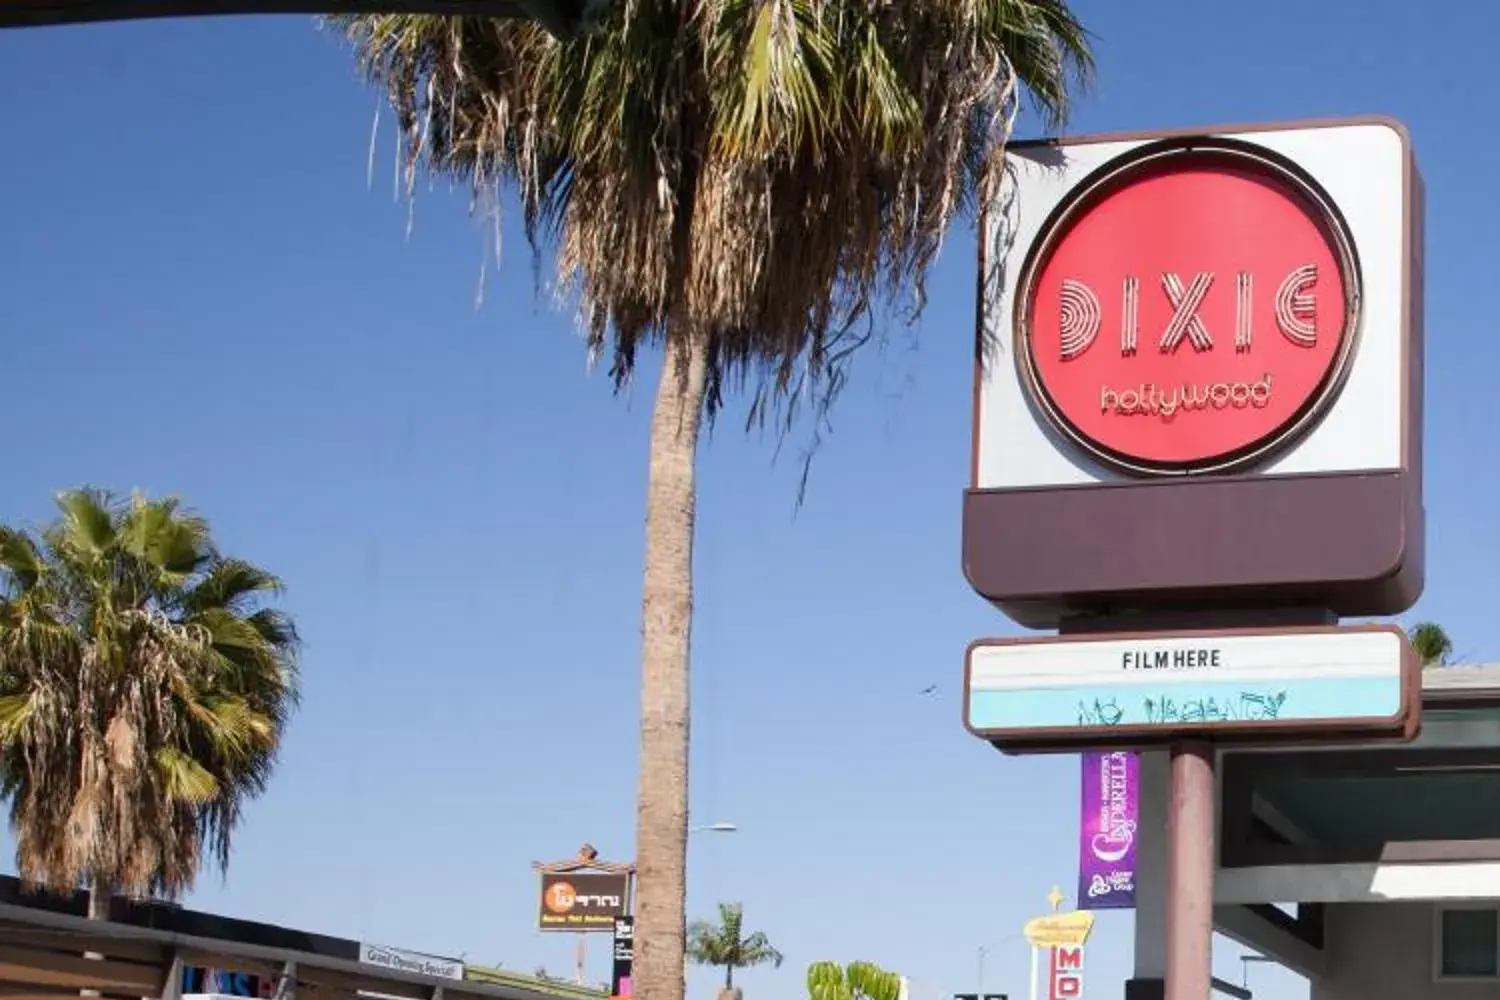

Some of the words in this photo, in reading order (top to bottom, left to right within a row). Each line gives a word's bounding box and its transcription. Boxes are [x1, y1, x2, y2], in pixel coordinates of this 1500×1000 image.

[1059, 263, 1318, 361] DIXIE
[1099, 374, 1272, 418] hollywood
[1122, 650, 1169, 670] FILM
[1173, 649, 1221, 668] HERE
